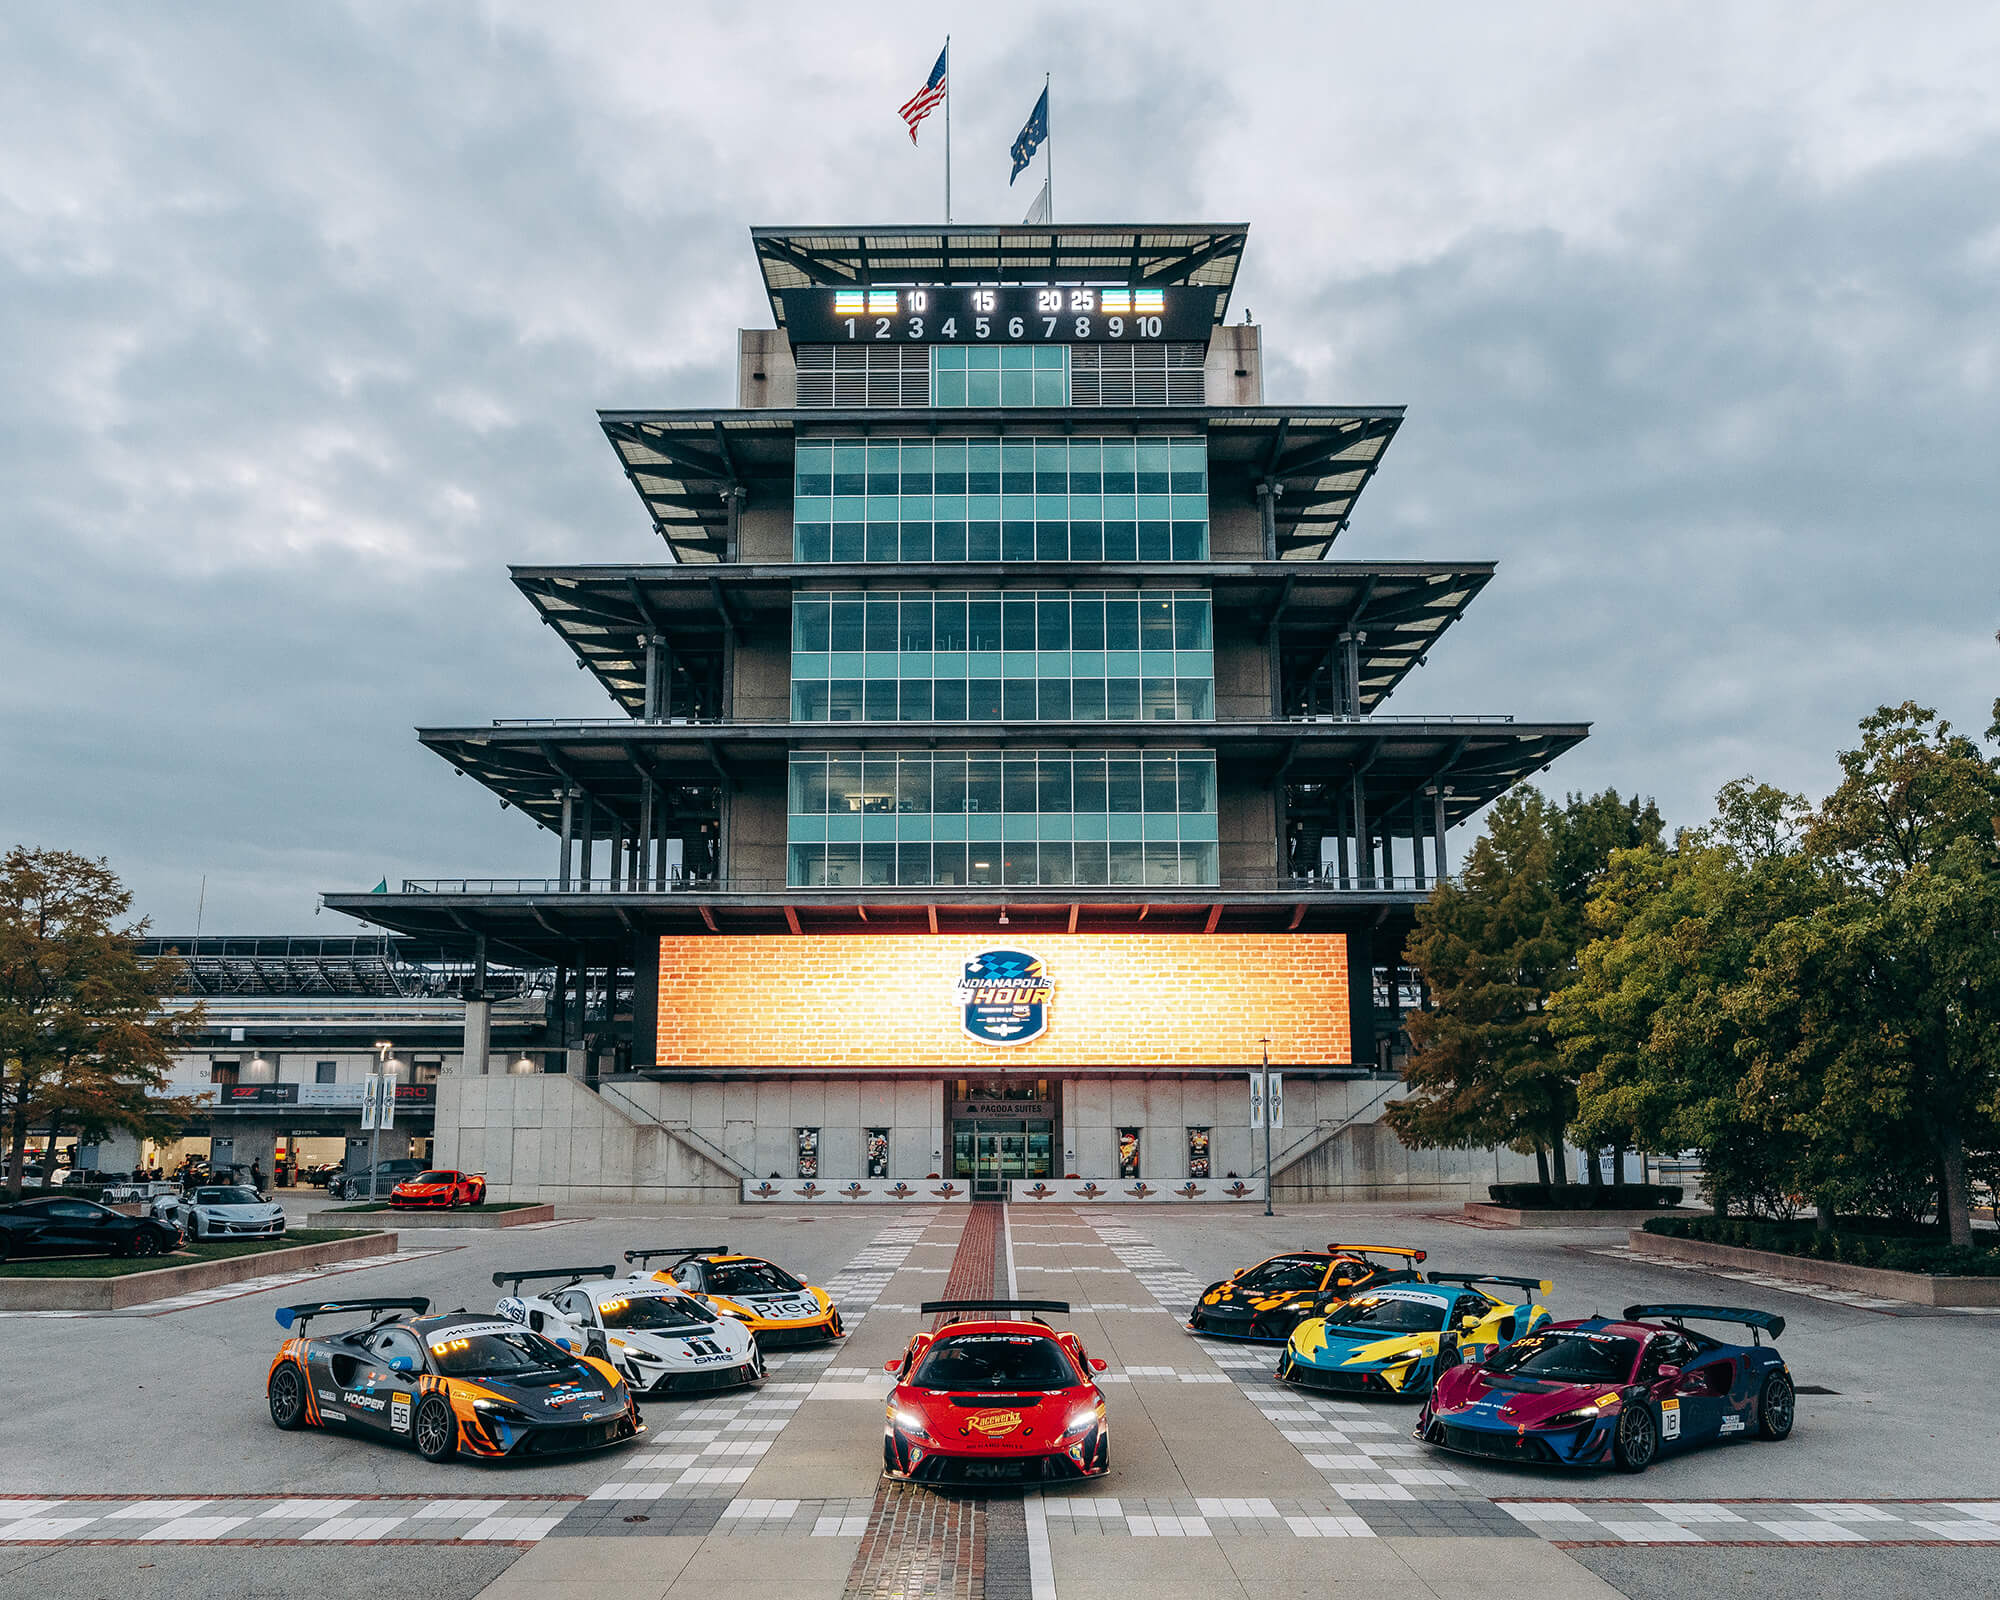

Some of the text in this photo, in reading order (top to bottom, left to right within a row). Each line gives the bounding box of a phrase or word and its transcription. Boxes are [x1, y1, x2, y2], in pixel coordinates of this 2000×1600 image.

[908, 291, 1094, 312] 10 15 20 25
[845, 317, 1162, 339] 1 2 3 4 5 6 7 8 9 10
[958, 978, 1052, 988] INDIANAPOLIS
[974, 988, 1051, 1004] HOUR
[980, 1104, 1042, 1113] PAGODA SUITES
[612, 1288, 669, 1299] McLaren
[498, 1298, 522, 1322] GMG
[752, 1299, 820, 1318] Pied
[445, 1323, 515, 1337] McLaren
[1541, 1329, 1627, 1342] McLaren
[949, 1336, 1043, 1345] McLaren
[694, 1354, 733, 1365] GMG
[344, 1392, 386, 1411] HOOPER
[544, 1390, 604, 1406] HOOPER
[393, 1407, 408, 1425] 56
[964, 1412, 1022, 1432] Racewerkz
[1666, 1414, 1677, 1431] 18
